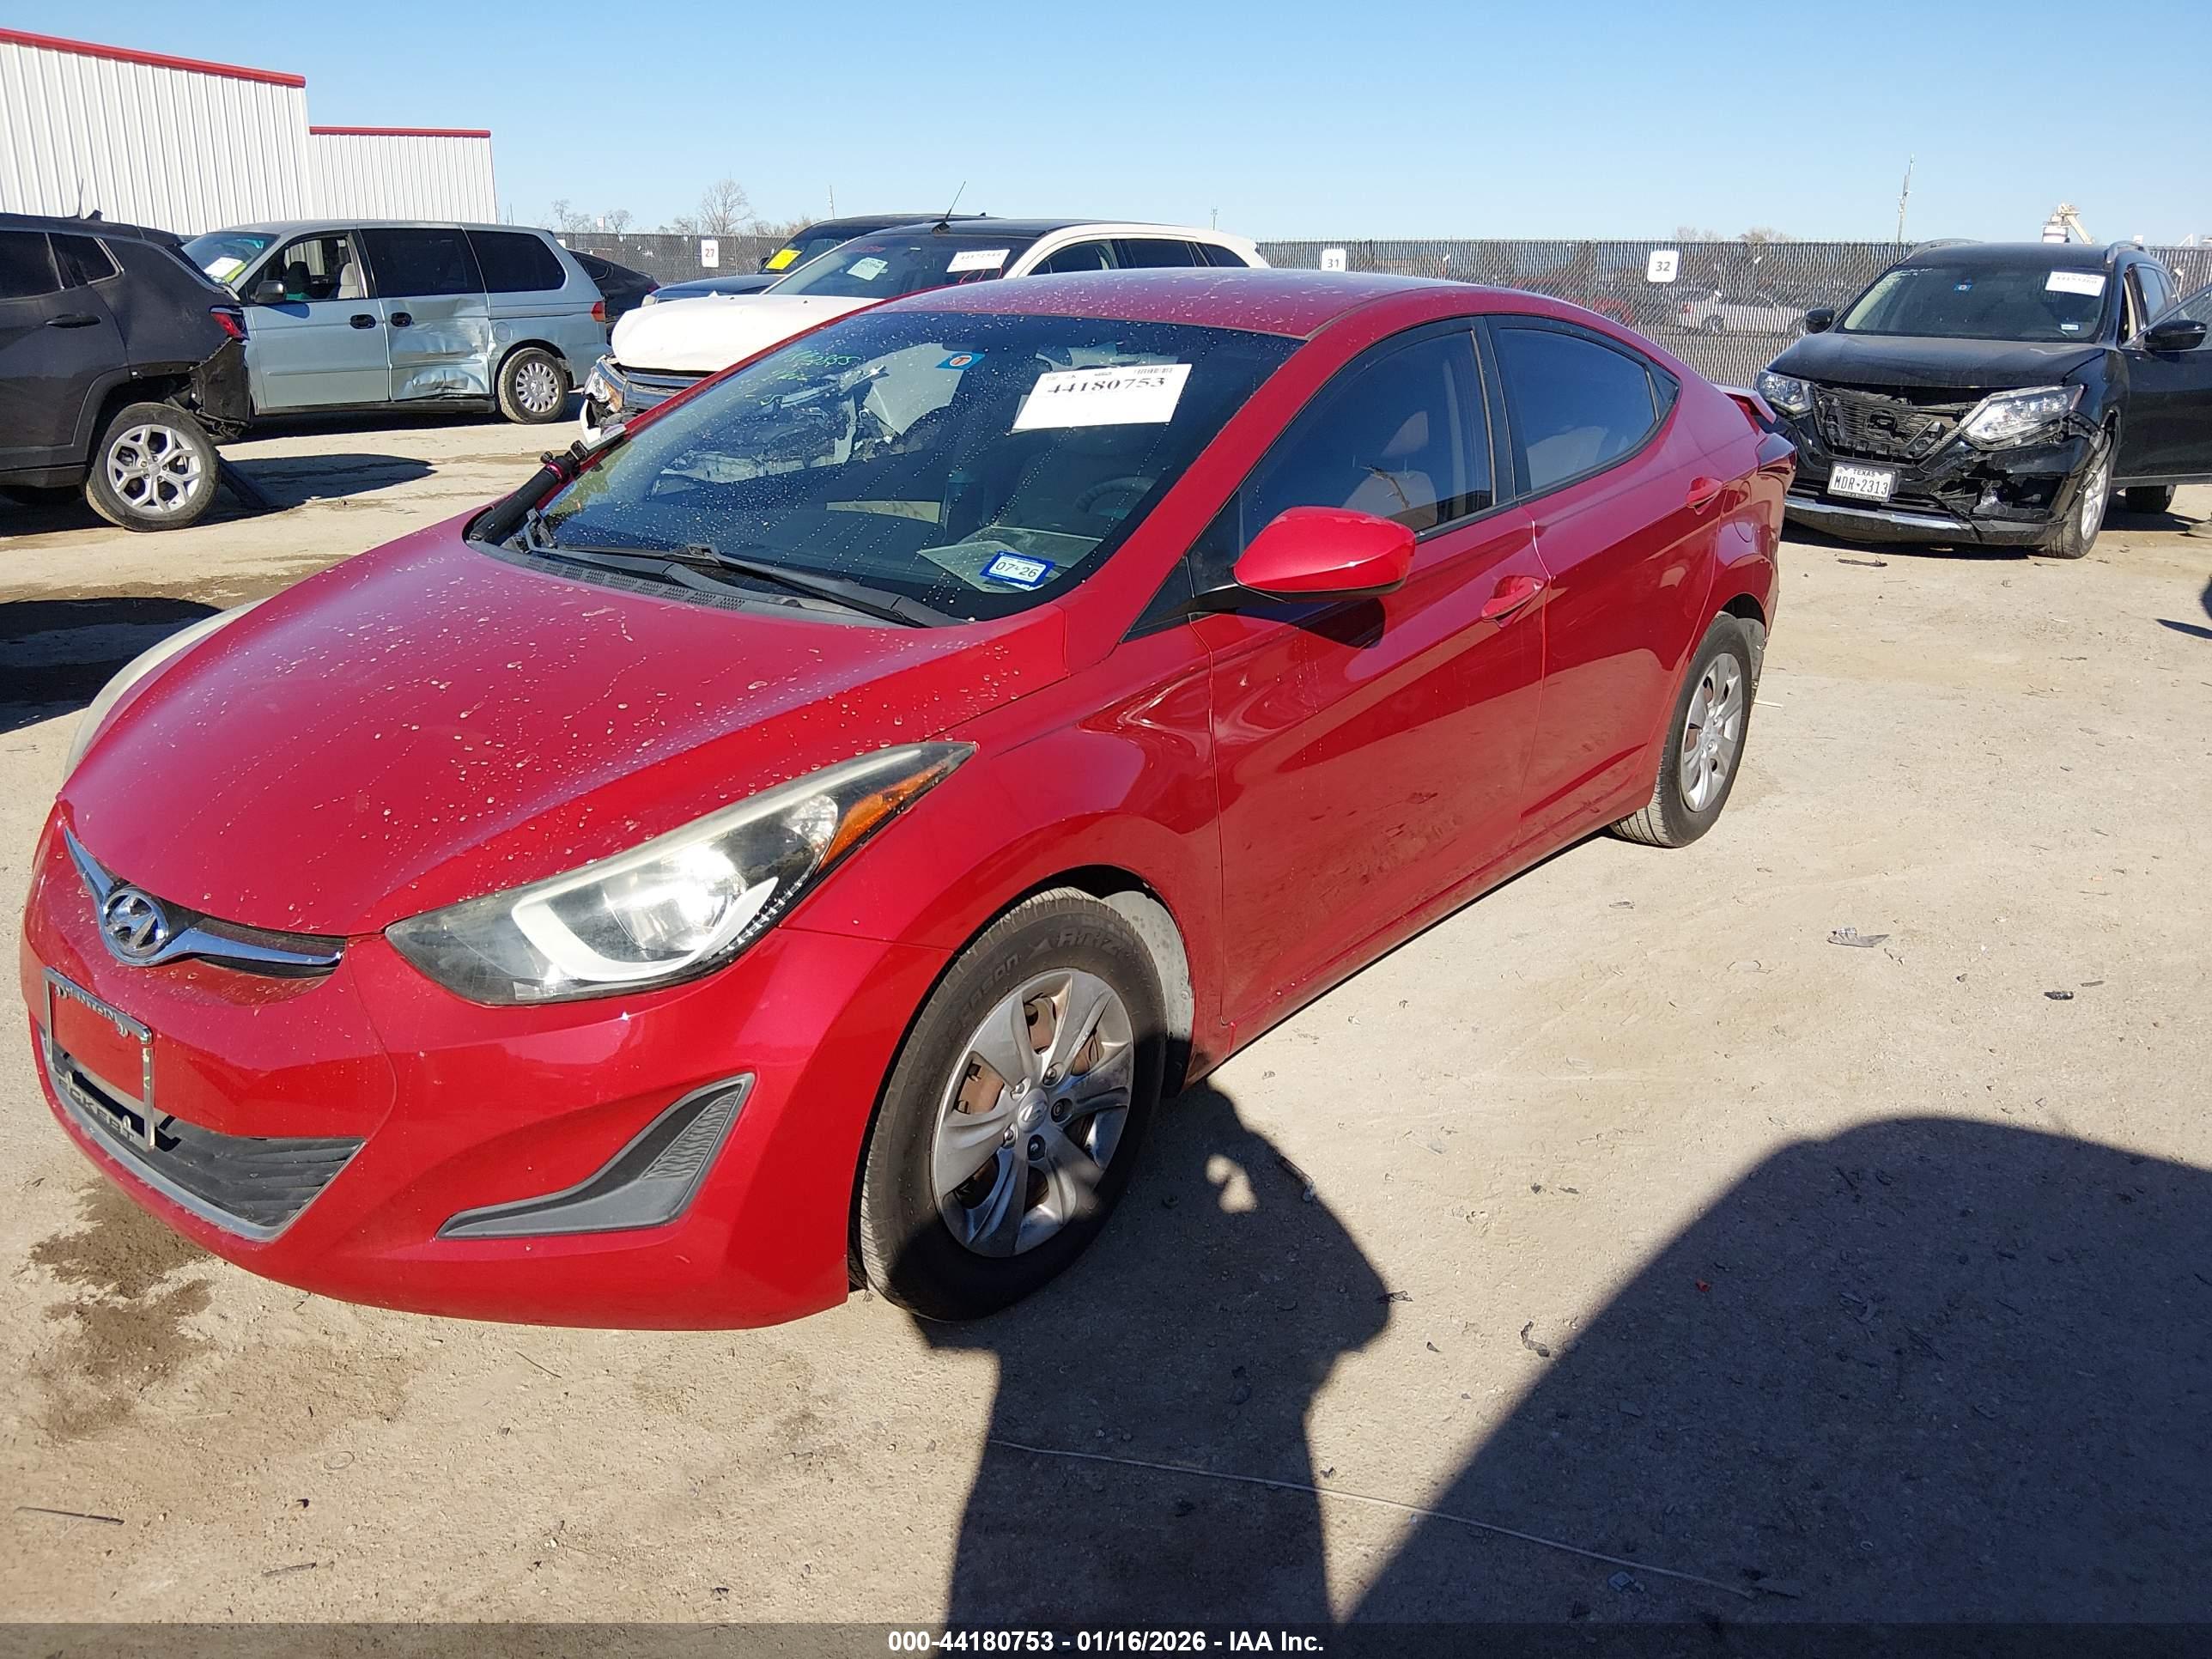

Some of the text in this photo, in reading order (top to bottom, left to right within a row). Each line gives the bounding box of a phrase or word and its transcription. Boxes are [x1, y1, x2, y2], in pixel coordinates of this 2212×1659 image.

[705, 248, 714, 258] 27
[1328, 258, 1340, 268] 31
[1656, 261, 1670, 272] 32
[1047, 376, 1165, 394] 44180753
[1854, 469, 1875, 477] TEXAS
